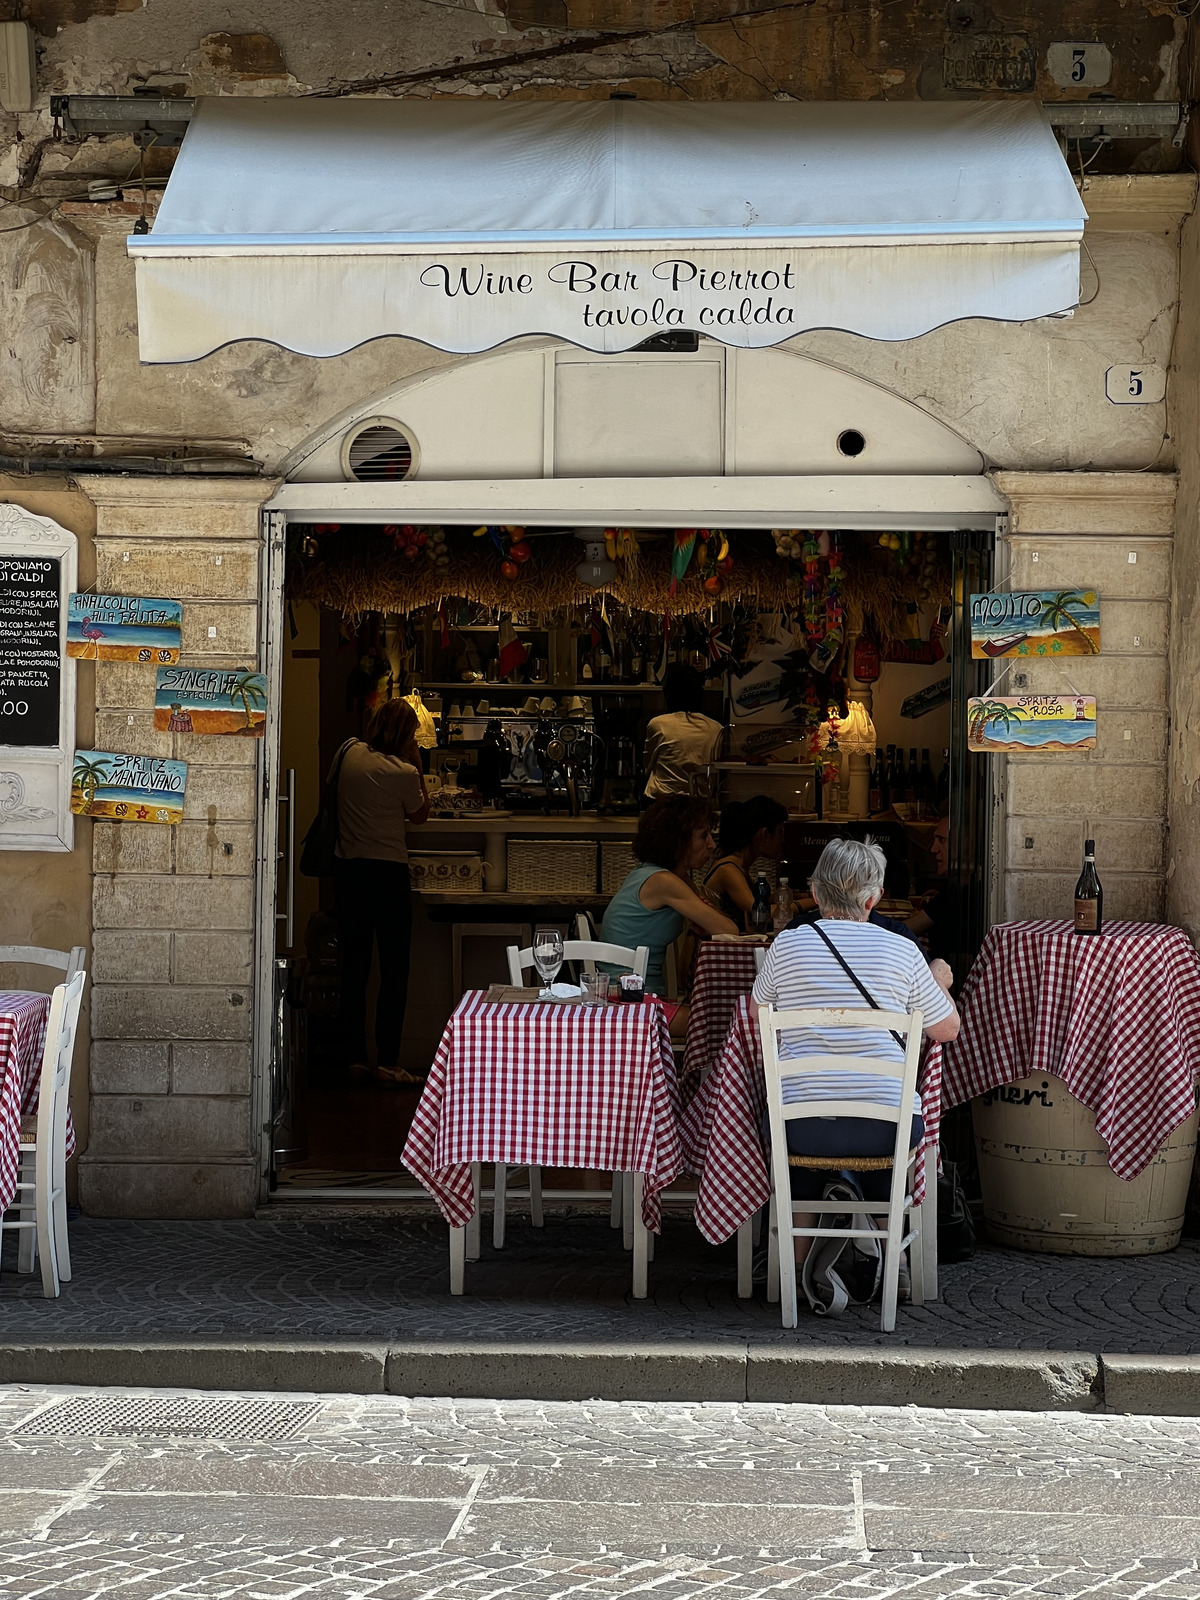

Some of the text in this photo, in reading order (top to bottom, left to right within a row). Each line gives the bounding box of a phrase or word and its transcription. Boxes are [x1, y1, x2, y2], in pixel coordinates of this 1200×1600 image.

[1071, 50, 1086, 82] 3
[419, 259, 795, 298] Wine Bar Pierrot
[582, 297, 795, 328] tavola calda
[1129, 370, 1143, 396] 5
[10, 572, 44, 583] CALDI
[30, 590, 57, 599] SPECK
[73, 596, 141, 611] ANALCOLICI
[91, 610, 168, 625] ALLA FRUTTA
[18, 679, 49, 688] RUCOLA
[160, 670, 239, 696] SANGRIA
[176, 690, 219, 702] ESPECIAL
[1017, 696, 1059, 706] SPRITZ
[1029, 705, 1064, 716] ROSA
[112, 754, 167, 774] SPRITZ
[107, 769, 182, 791] MANTOVANO
[800, 836, 828, 846] Menu
